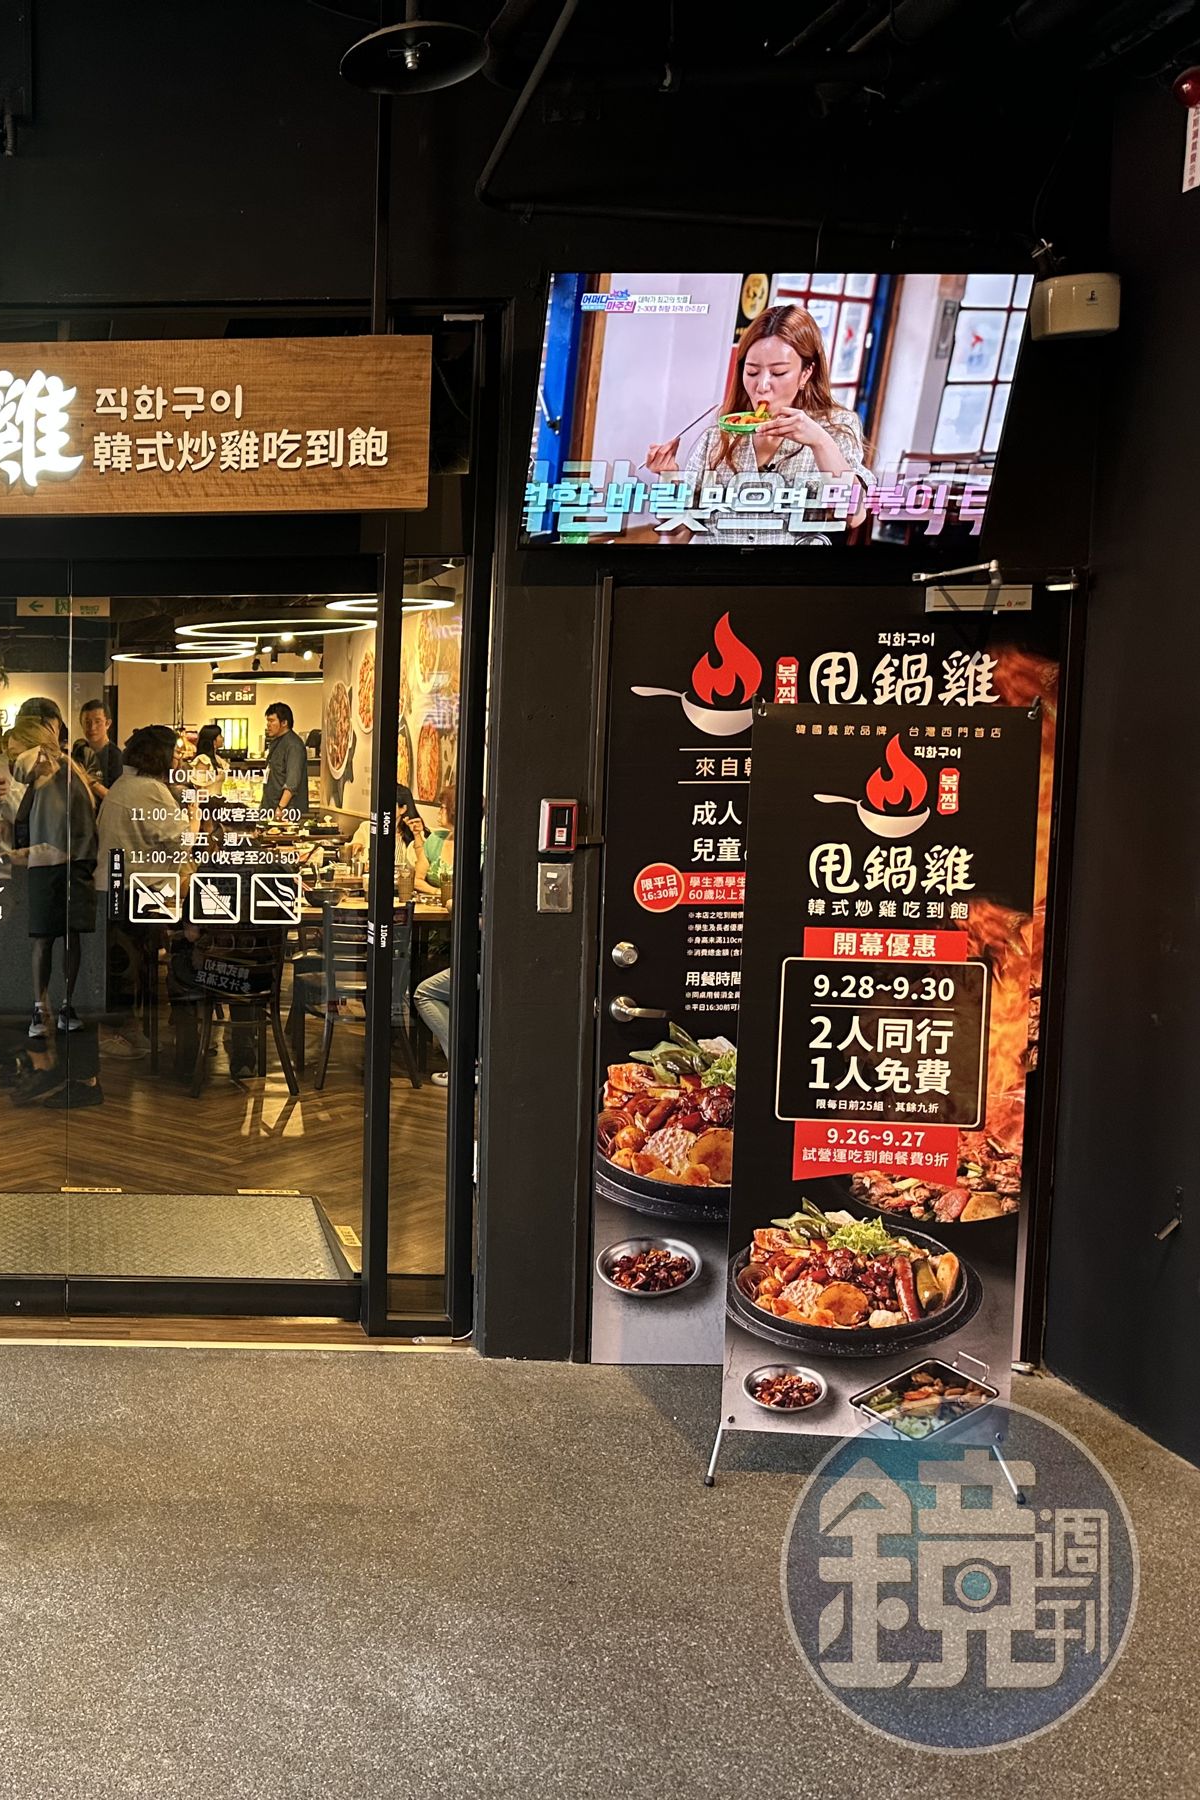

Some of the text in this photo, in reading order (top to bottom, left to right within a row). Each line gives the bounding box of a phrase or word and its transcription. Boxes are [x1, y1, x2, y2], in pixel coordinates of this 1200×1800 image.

[94, 384, 245, 421] 직화구이
[93, 429, 389, 473] 韓式炒雞吃到飽
[878, 632, 935, 648] 직화구이
[777, 663, 798, 704] 볶찜
[809, 650, 1001, 706] 甩鍋雞
[209, 691, 254, 701] Self Bar
[796, 724, 1002, 739] 韓國餐飲品牌 台灣西門首店
[914, 745, 961, 759] 직화구이
[940, 775, 958, 810] 볶찜
[383, 811, 391, 835] 140cm
[692, 801, 743, 826] 成人
[691, 837, 742, 862] 兒童
[809, 842, 976, 896] 甩鍋雞
[640, 874, 678, 891] 限平日
[641, 887, 679, 901] 16:30前
[807, 898, 969, 920] 韓式炒雞吃到飽
[380, 924, 388, 948] 110cm
[833, 931, 937, 958] 開幕優惠
[686, 971, 741, 987] 用餐時間
[812, 974, 955, 1002] 9.28~9.30
[808, 1015, 954, 1055] 2人同行
[807, 1056, 951, 1096] 1人免費
[827, 1127, 926, 1147] 9.26~9.27
[802, 1146, 950, 1168] 試營運吃到飽餐費9折
